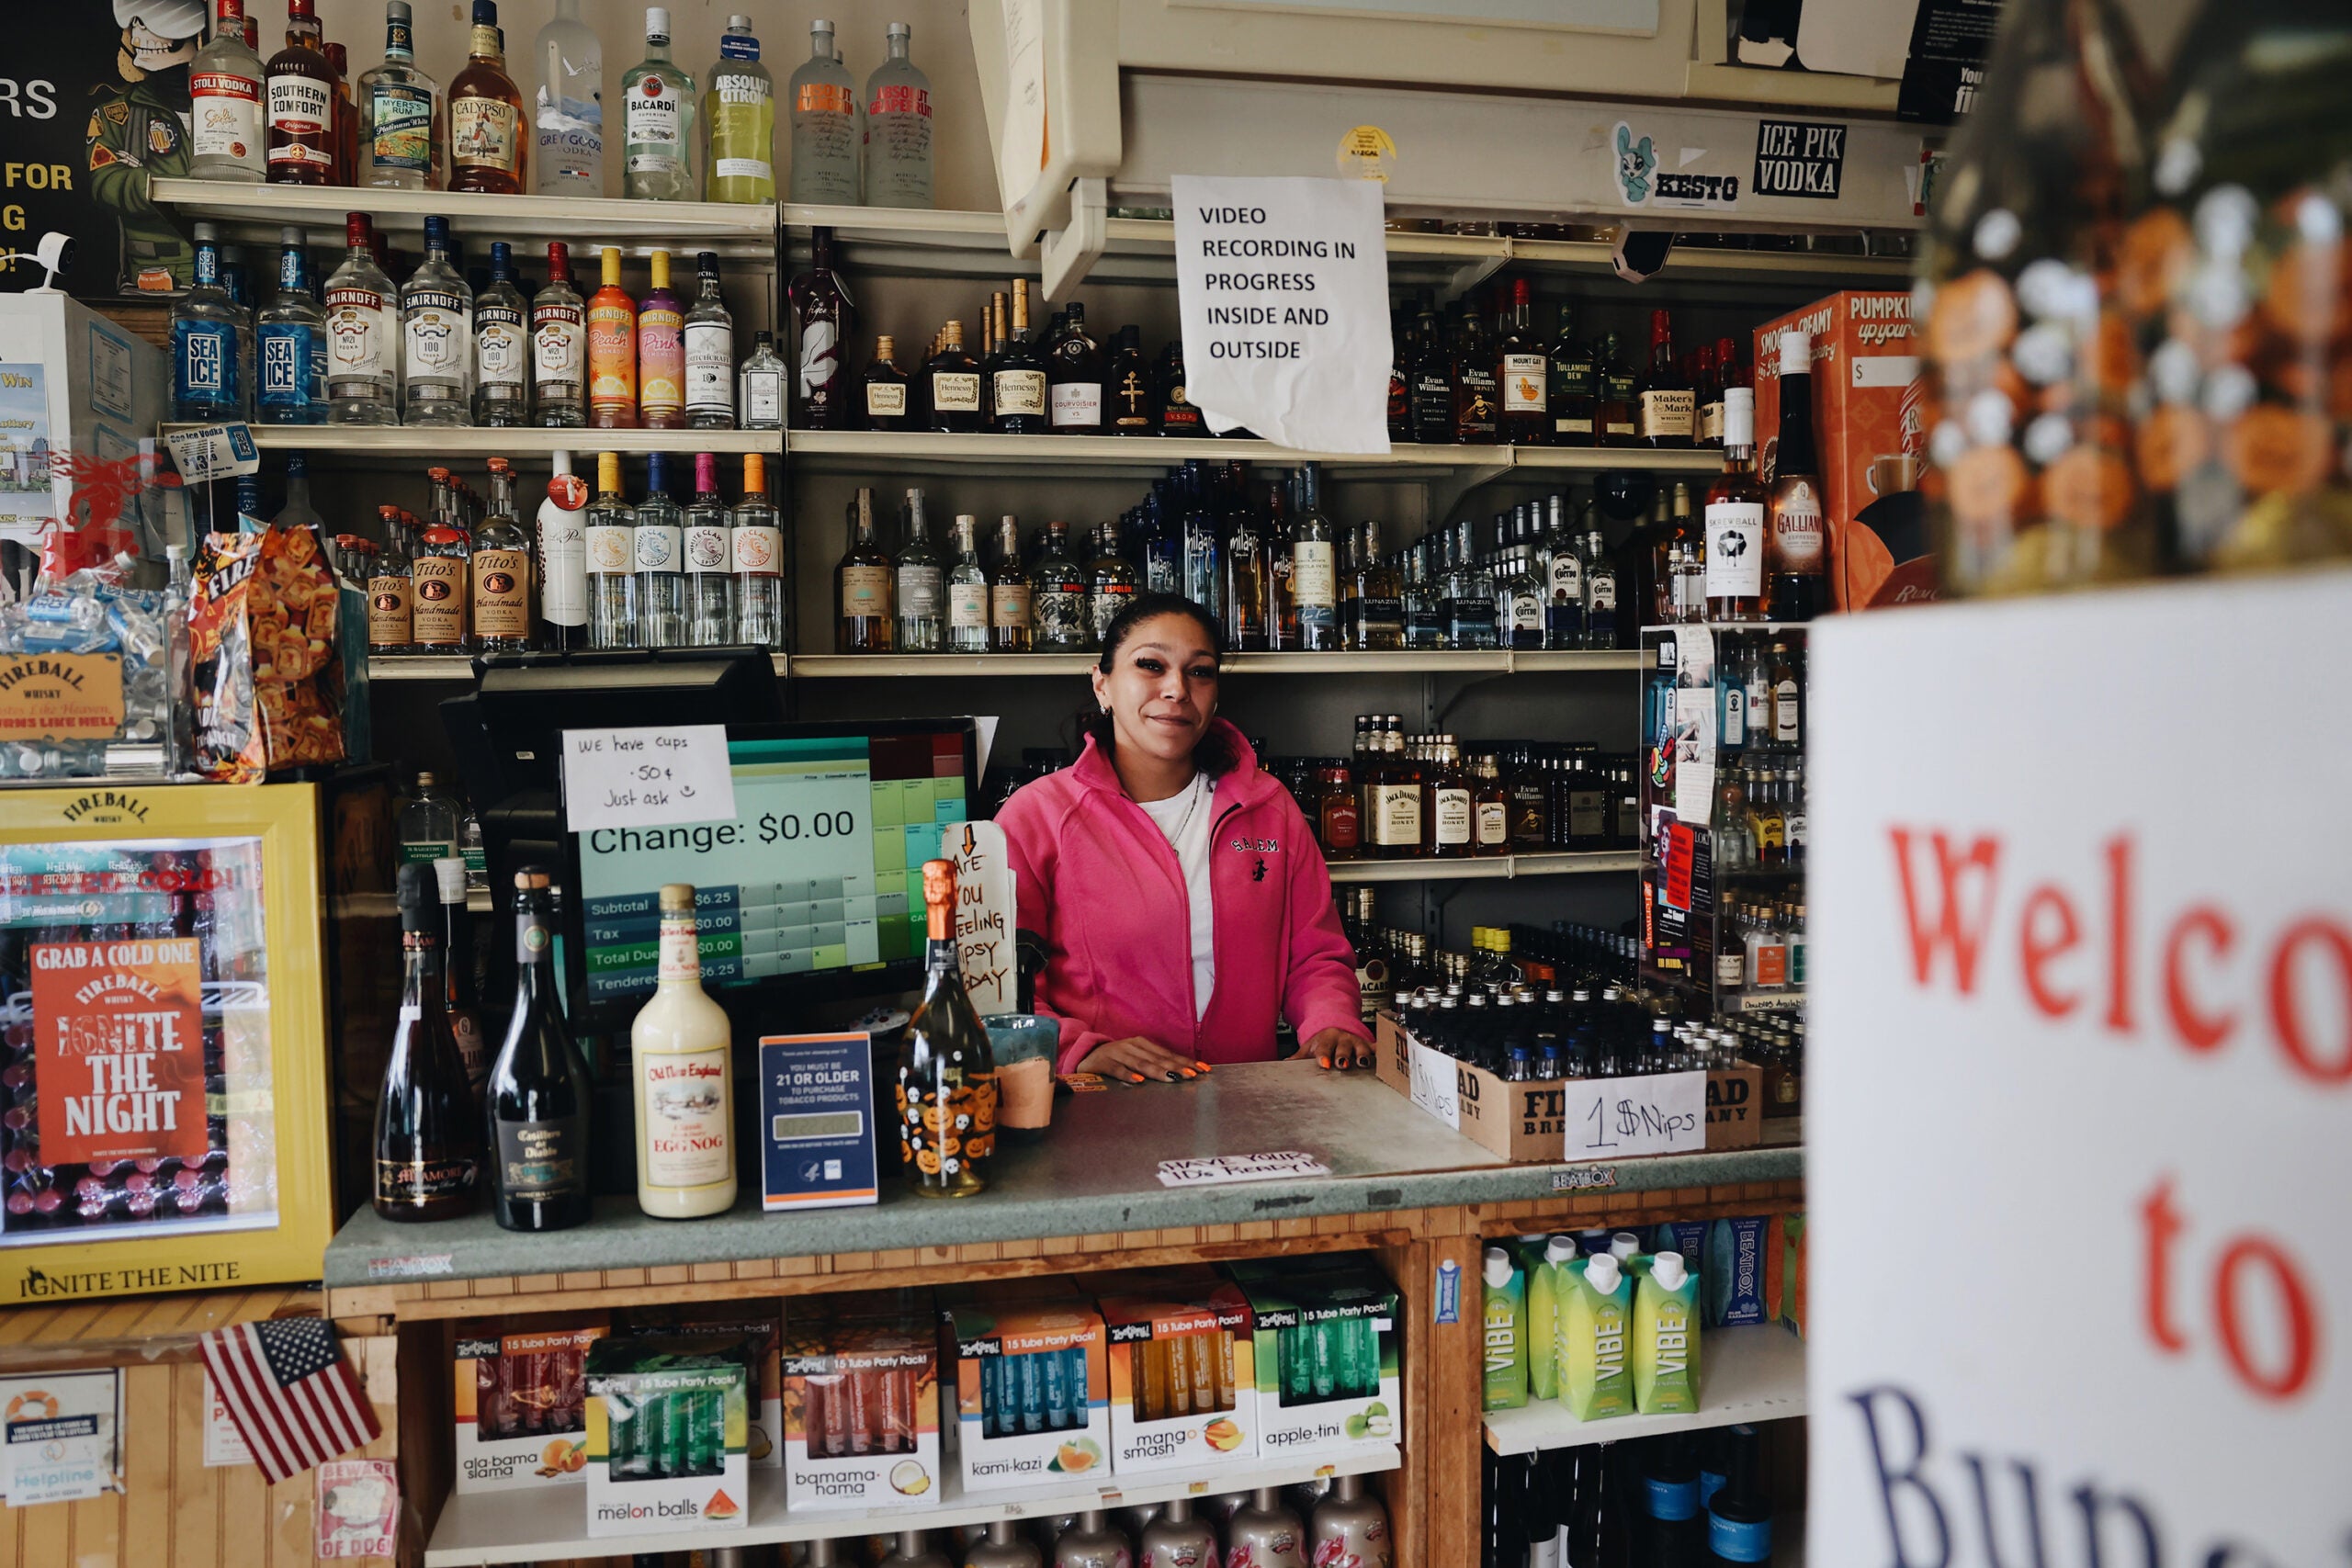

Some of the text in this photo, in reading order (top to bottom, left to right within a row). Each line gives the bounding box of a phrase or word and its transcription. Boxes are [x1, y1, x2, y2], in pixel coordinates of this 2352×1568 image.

[194, 78, 253, 95] STOLI VODKA
[716, 75, 769, 91] ABSOLUT
[271, 85, 326, 105] SOUTHERN
[719, 89, 765, 106] CITRON
[274, 101, 323, 118] COMFORT
[392, 107, 413, 116] RUM
[456, 101, 505, 118] CALYPSO
[376, 117, 429, 136] Platinum White
[1760, 124, 1841, 159] ICE PIK
[6, 164, 72, 190] FOR
[1758, 160, 1836, 194] VODKA
[1655, 173, 1739, 201] KESTO
[1199, 207, 1266, 224] VIDEO
[1203, 240, 1355, 259] RECORDING IN
[1205, 273, 1316, 291] PROGRESS
[1207, 307, 1329, 325] INSIDE AND
[190, 337, 219, 359] SEA
[590, 331, 628, 348] Peach
[643, 332, 677, 349] Pink
[266, 341, 292, 361] SEA
[1210, 341, 1300, 358] OUTSIDE
[190, 359, 219, 384] ICE
[267, 362, 292, 386] ICE
[1468, 368, 1489, 378] Evan
[1556, 361, 1592, 373] TULLAMORE
[941, 384, 972, 393] Hennessy
[1001, 383, 1037, 393] Hennessy
[1419, 384, 1450, 393] Williams
[1425, 376, 1443, 385] Evan
[1462, 377, 1496, 386] Williams
[1055, 400, 1097, 409] COURVOISIER
[1654, 394, 1692, 405] Maker's
[1665, 403, 1691, 412] Mark
[416, 560, 456, 577] Tito's
[479, 555, 519, 570] Tito's
[1555, 568, 1577, 580] Cuervo
[371, 579, 404, 592] Tito's
[414, 604, 459, 615] Handmade
[476, 596, 523, 608] Handmade
[369, 613, 409, 623] Handmade
[1515, 605, 1537, 617] Cuervo
[24, 690, 61, 699] WHISKY
[579, 739, 604, 754] WE
[614, 735, 644, 751] have
[604, 788, 669, 808] Just ask
[62, 791, 150, 824] FIREBALL
[591, 810, 855, 855] Change: $0.00
[1231, 837, 1279, 853] SALEM
[591, 891, 731, 917] Subtotal $6.25
[593, 916, 732, 942] Tax $0.00
[36, 942, 196, 970] GRAB A COLD ONE
[595, 940, 734, 967] Total Due $0.00
[698, 964, 735, 979] $6.25
[75, 974, 162, 1005] FIREBALL
[104, 994, 134, 1005] WHISKY
[56, 1011, 184, 1056] IGNITE
[85, 1053, 158, 1094] THE
[790, 1062, 842, 1072] YOU MUST BE
[776, 1070, 860, 1086] 21 OR OLDER
[791, 1085, 845, 1095] TO PURCHASE
[778, 1093, 860, 1105] TOBACCO PRODUCTS
[64, 1091, 181, 1136] NIGHT
[691, 1134, 723, 1150] NOG
[1553, 1168, 1614, 1190] BEATBOX
[1738, 1231, 1755, 1297] BEATBOX
[20, 1261, 241, 1297] IGNITE THE NITE
[2138, 1177, 2321, 1404] to
[1303, 1303, 1387, 1321] 15 Tube Party Pack!
[1157, 1315, 1244, 1333] 15 Tube Party Pack!
[1007, 1332, 1096, 1349] 15 Tube Party Pack!
[834, 1355, 927, 1369] 15 Tube Party Pack!
[1136, 1428, 1197, 1447] mango
[1124, 1442, 1175, 1461] smash
[323, 1462, 393, 1480] BEWARE
[467, 1464, 514, 1480] slama
[597, 1499, 698, 1521] melon balls
[323, 1537, 392, 1557] OF DOG!
